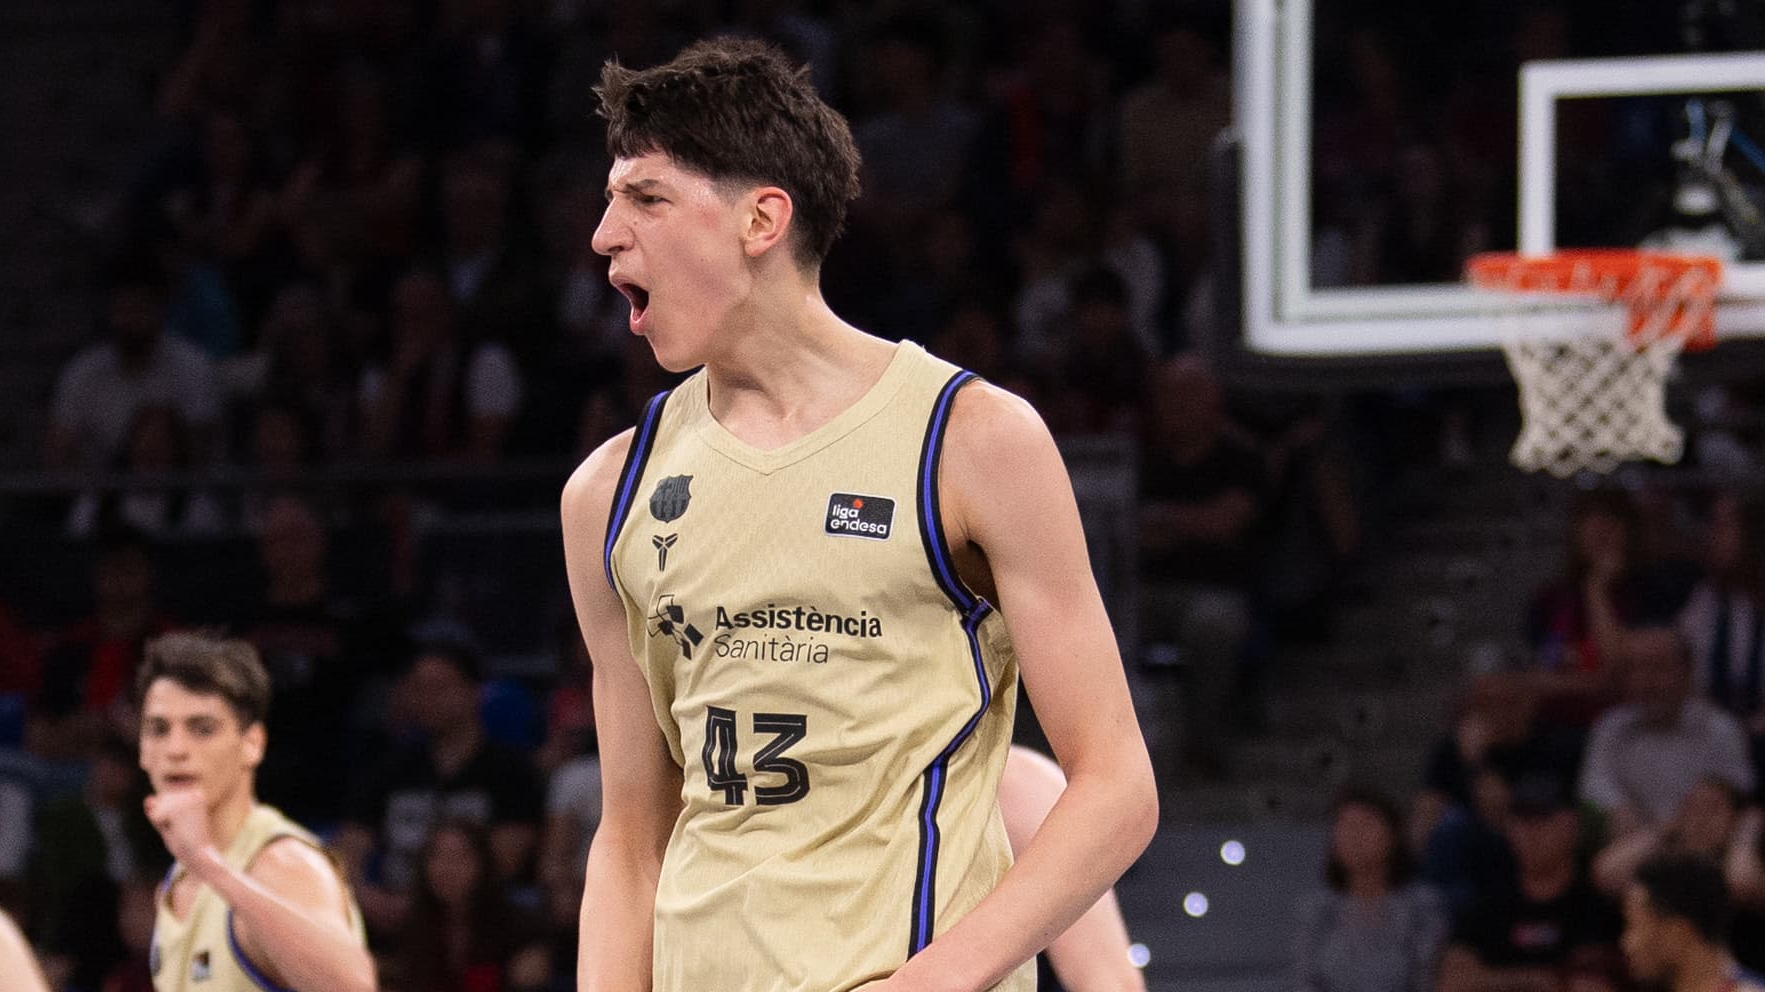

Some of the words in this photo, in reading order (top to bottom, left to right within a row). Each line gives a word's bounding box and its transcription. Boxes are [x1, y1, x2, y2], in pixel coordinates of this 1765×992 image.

[830, 519, 887, 534] endesa
[832, 504, 859, 519] liga
[715, 604, 882, 638] Assistència
[714, 633, 829, 664] Sanitària
[702, 705, 810, 805] 43
